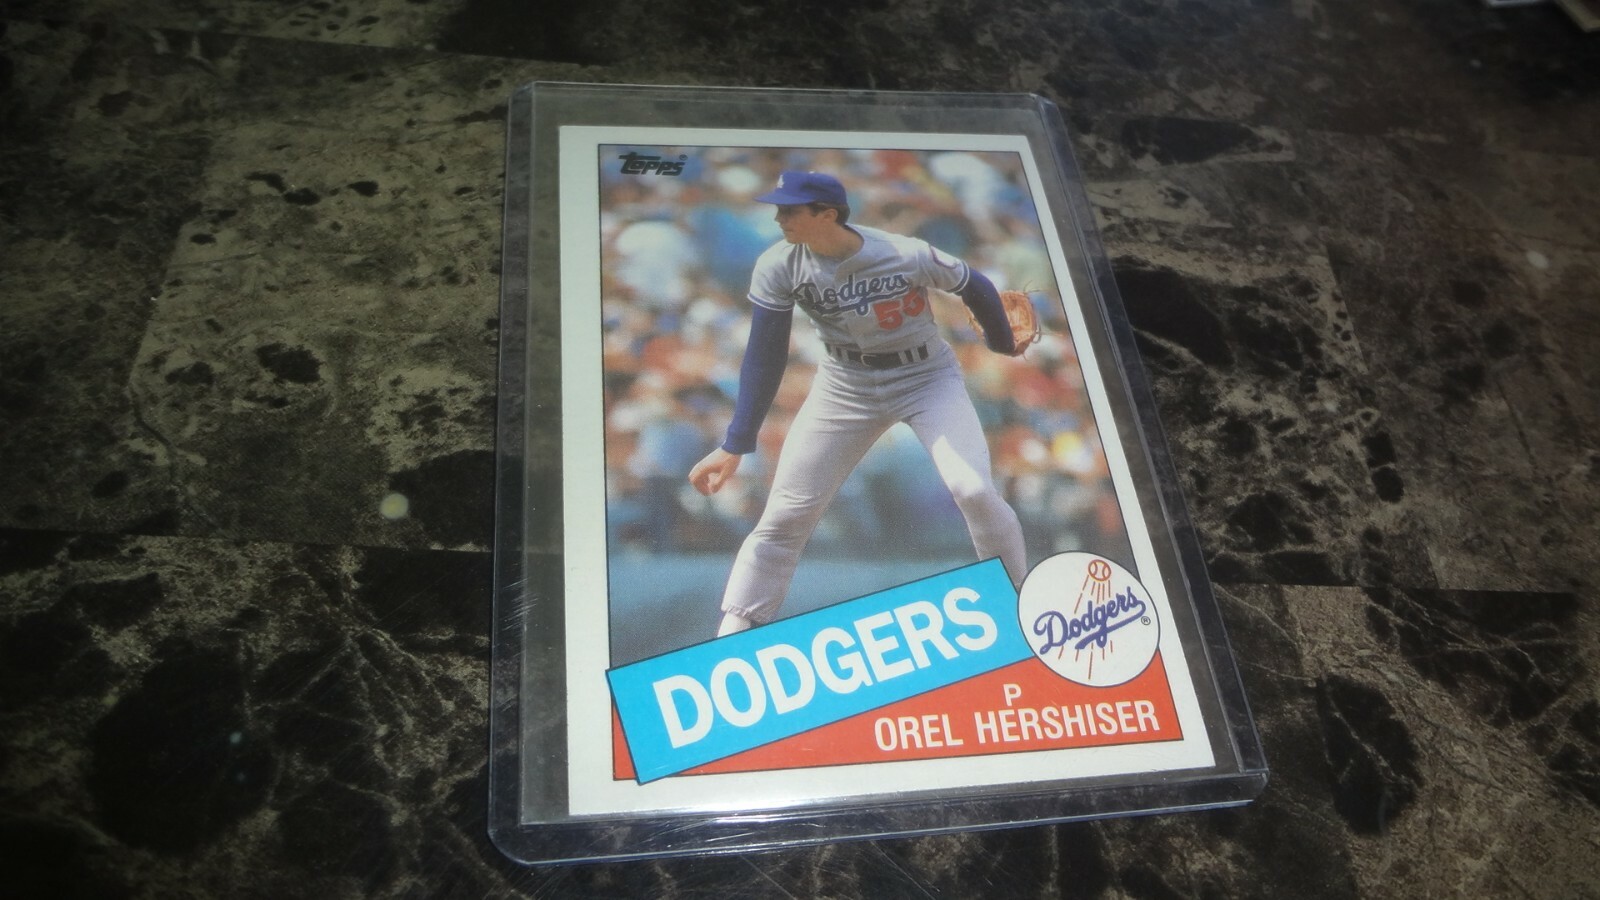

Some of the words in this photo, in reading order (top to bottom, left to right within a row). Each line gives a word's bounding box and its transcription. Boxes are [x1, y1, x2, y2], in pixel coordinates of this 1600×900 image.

[792, 273, 911, 316] Dodgers
[1033, 586, 1146, 655] Dodgers
[652, 586, 998, 749] DODGERS
[1003, 683, 1022, 706] P
[874, 717, 963, 751] OREL
[974, 700, 1160, 744] HERSHISER
